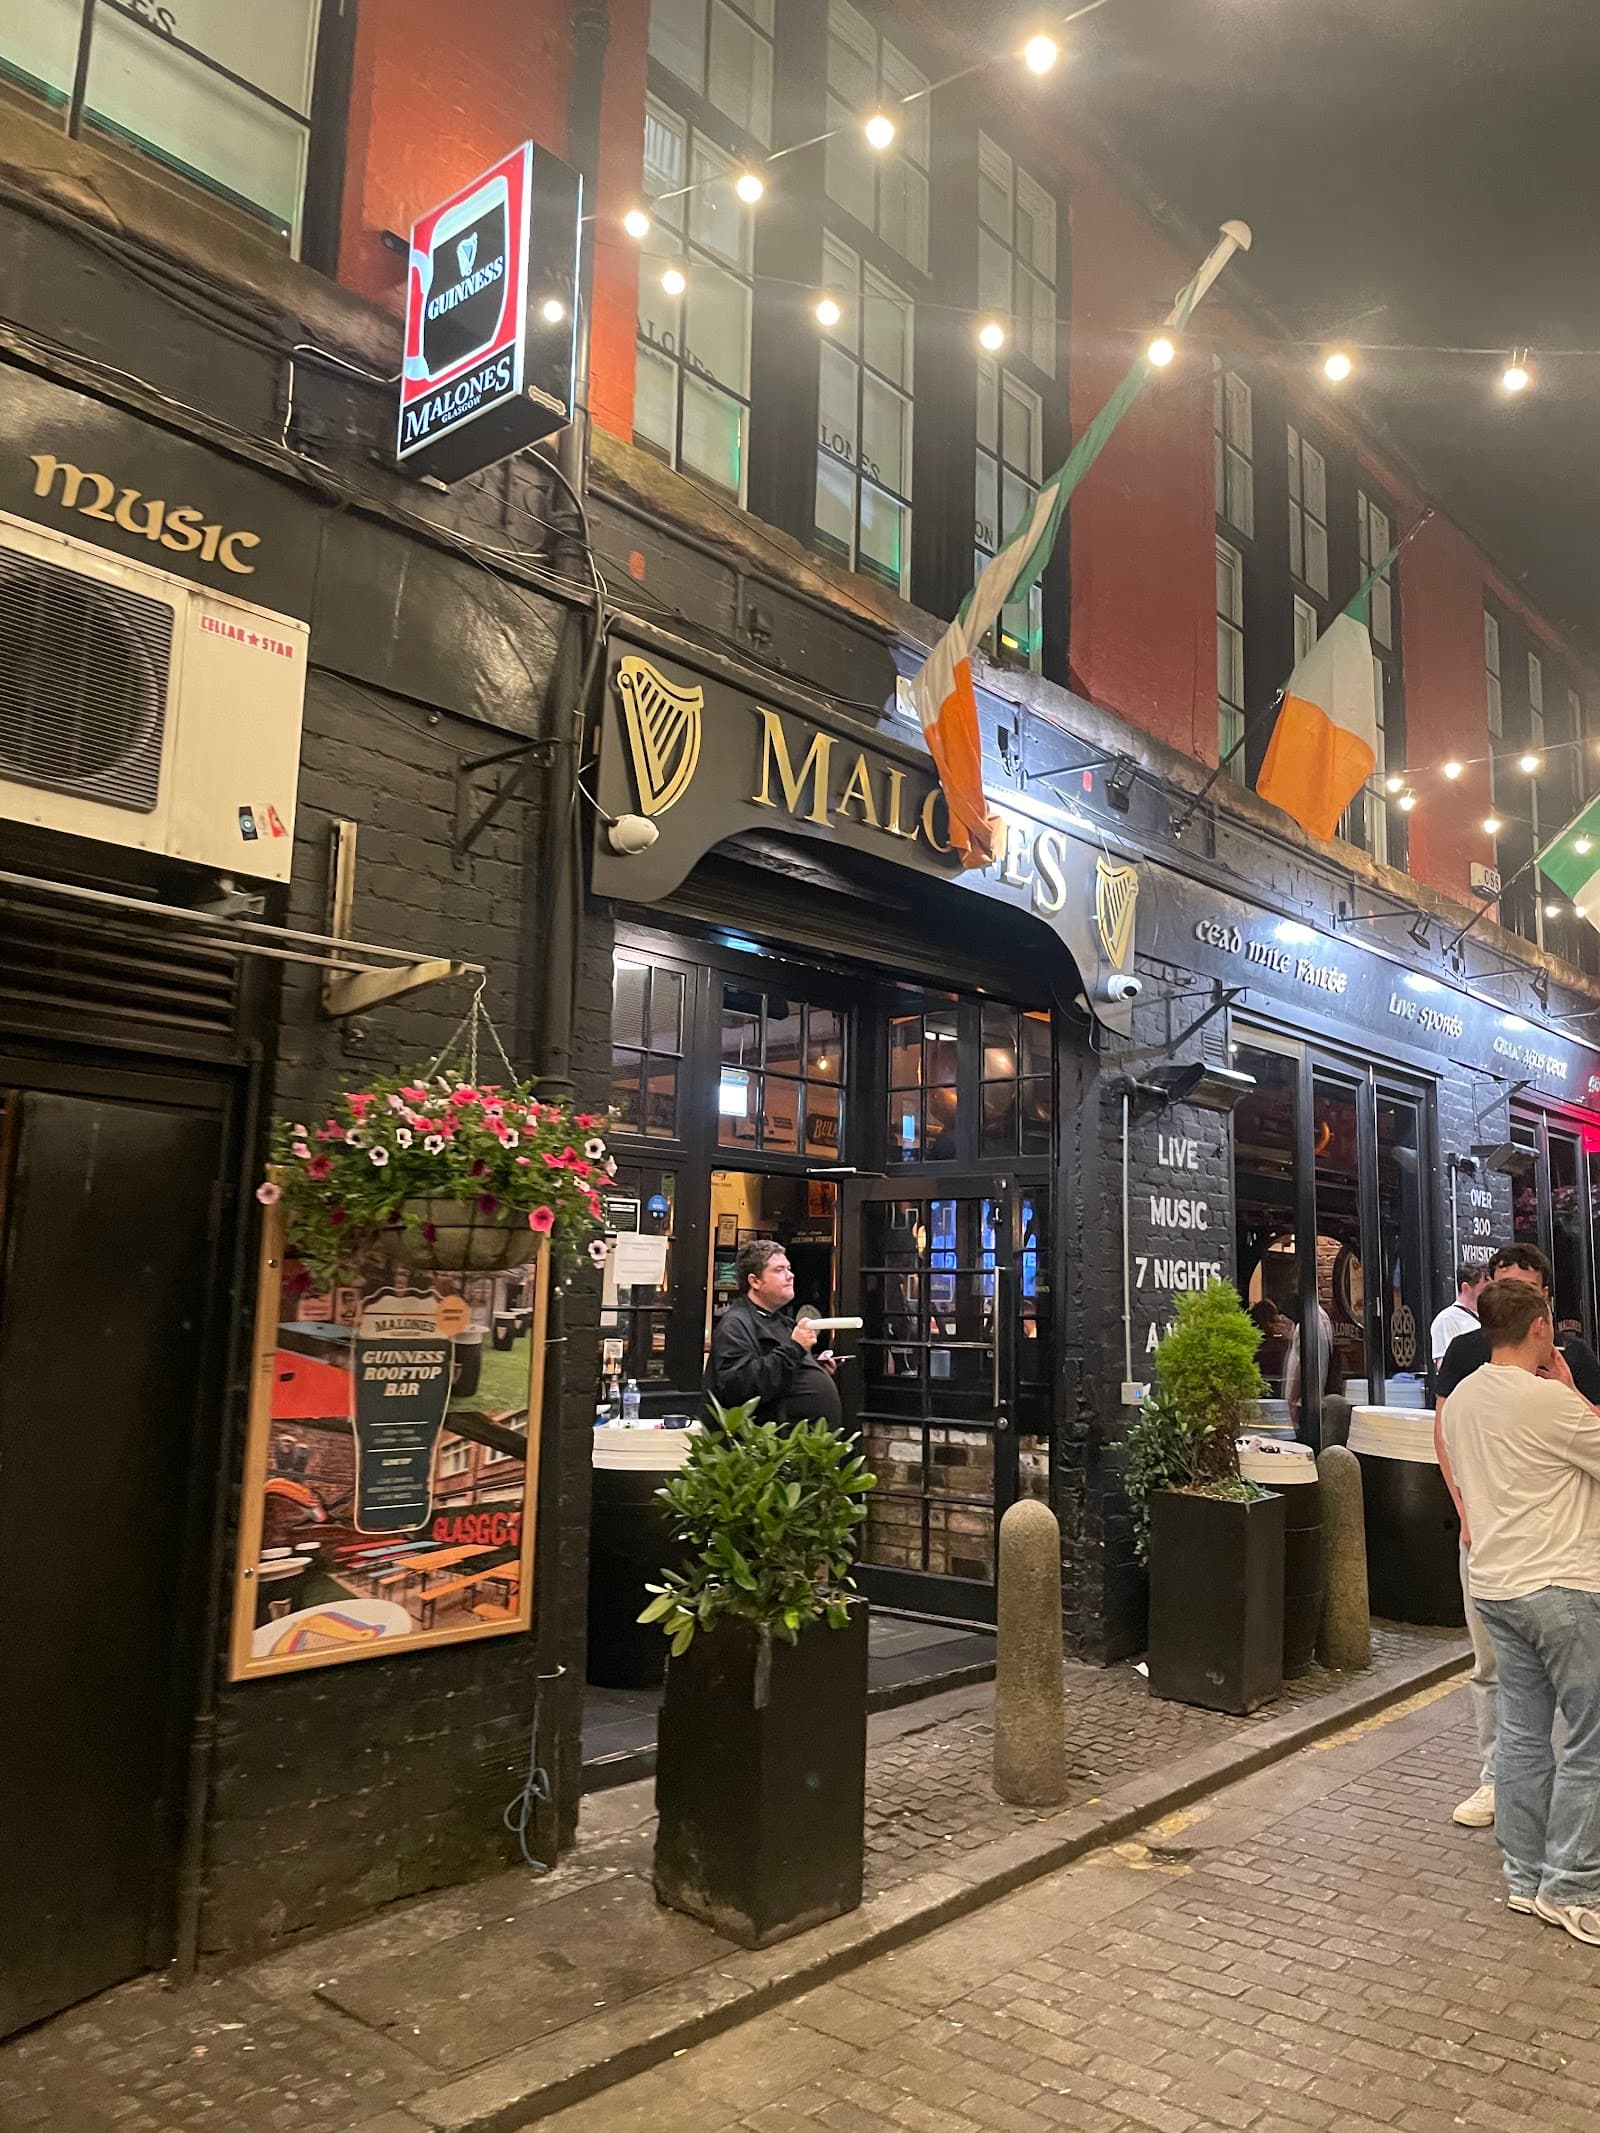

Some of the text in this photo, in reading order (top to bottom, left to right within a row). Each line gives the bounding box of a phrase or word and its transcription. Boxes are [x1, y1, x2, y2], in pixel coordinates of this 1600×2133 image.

[427, 255, 505, 320] GUINNESS
[404, 355, 512, 444] MALONES
[441, 394, 482, 424] GLASGOW
[201, 615, 294, 658] CELLAR STAR
[1158, 1134, 1199, 1169] LIVE
[1150, 1195, 1209, 1232] MUSIC
[1470, 1188, 1493, 1210] OVER
[1473, 1217, 1491, 1237] 300
[1135, 1257, 1222, 1292] 7 NIGHTS
[375, 1318, 437, 1333] MALONES
[362, 1350, 446, 1365] GUINNESS
[363, 1366, 443, 1381] ROOFTOP
[383, 1382, 420, 1397] BAR
